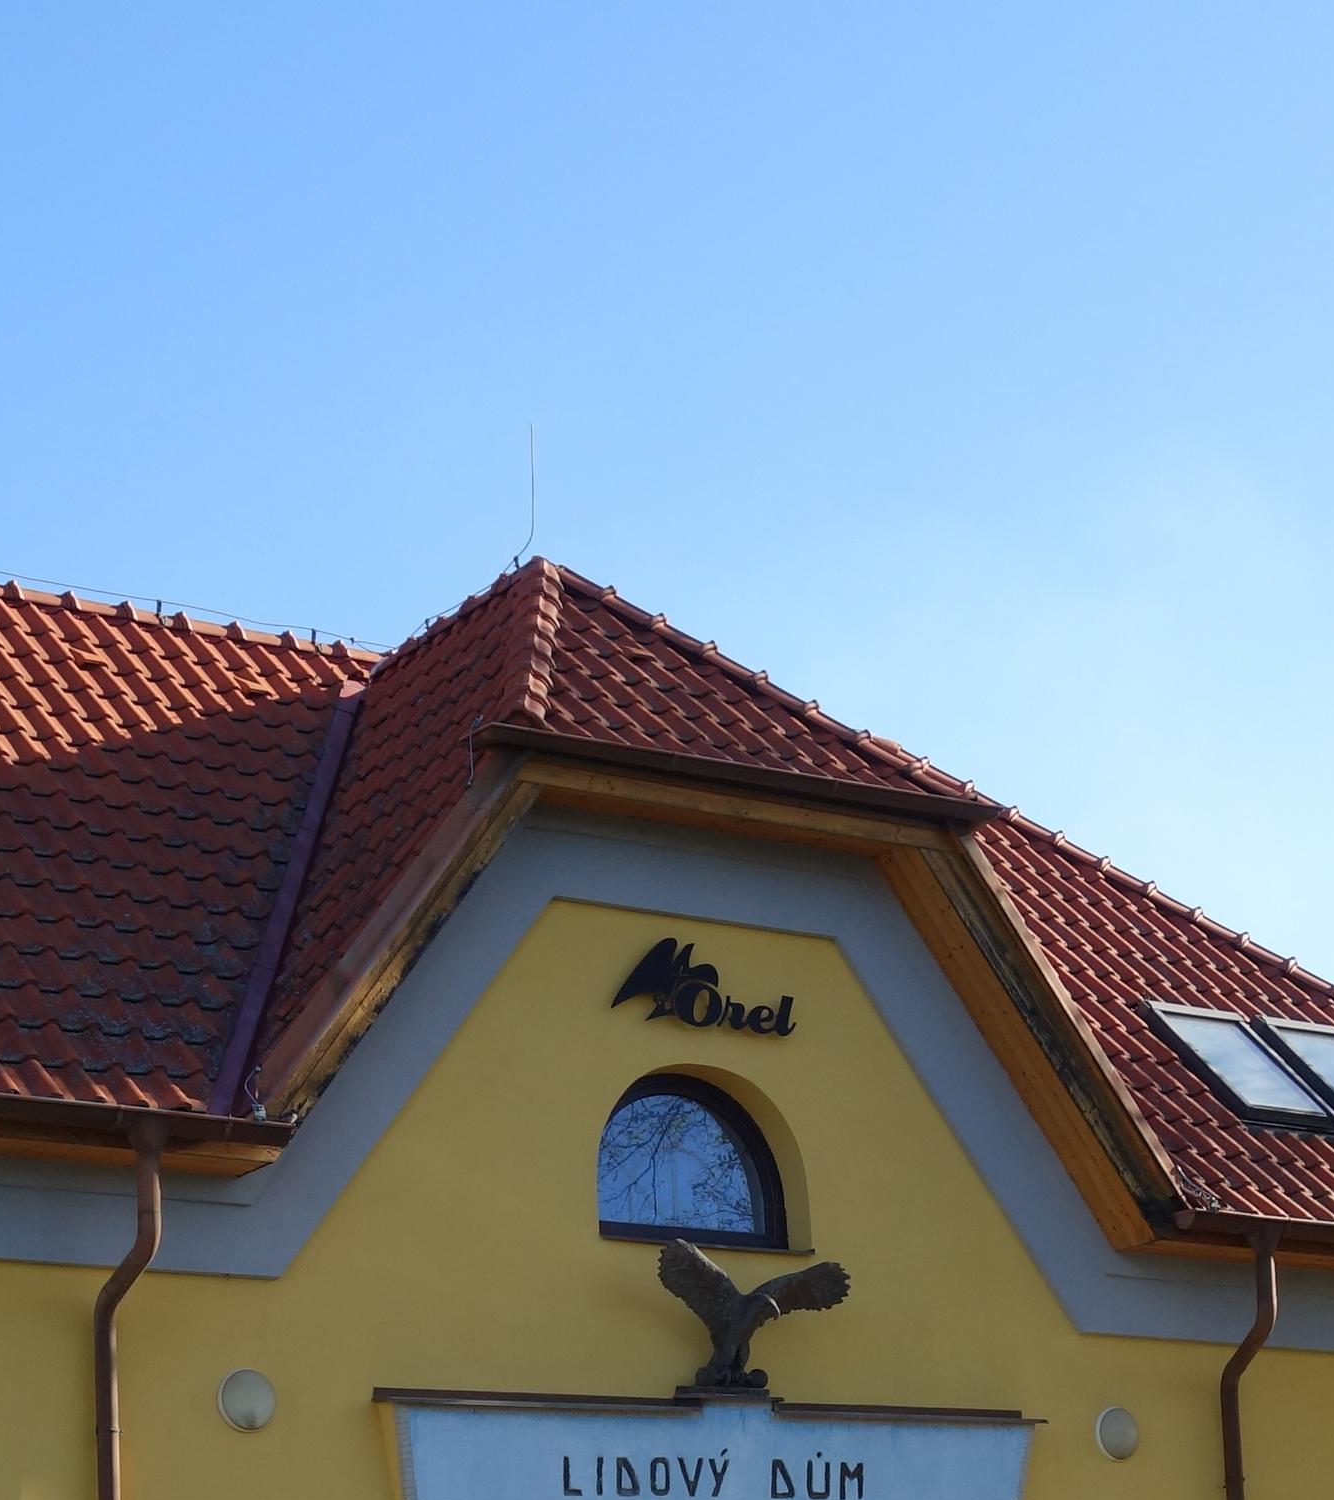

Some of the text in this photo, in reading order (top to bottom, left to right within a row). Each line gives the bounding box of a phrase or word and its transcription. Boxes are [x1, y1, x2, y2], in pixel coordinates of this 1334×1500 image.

[674, 980, 797, 1038] Orel
[563, 1448, 865, 1500] LIDOVÝ DŮM
